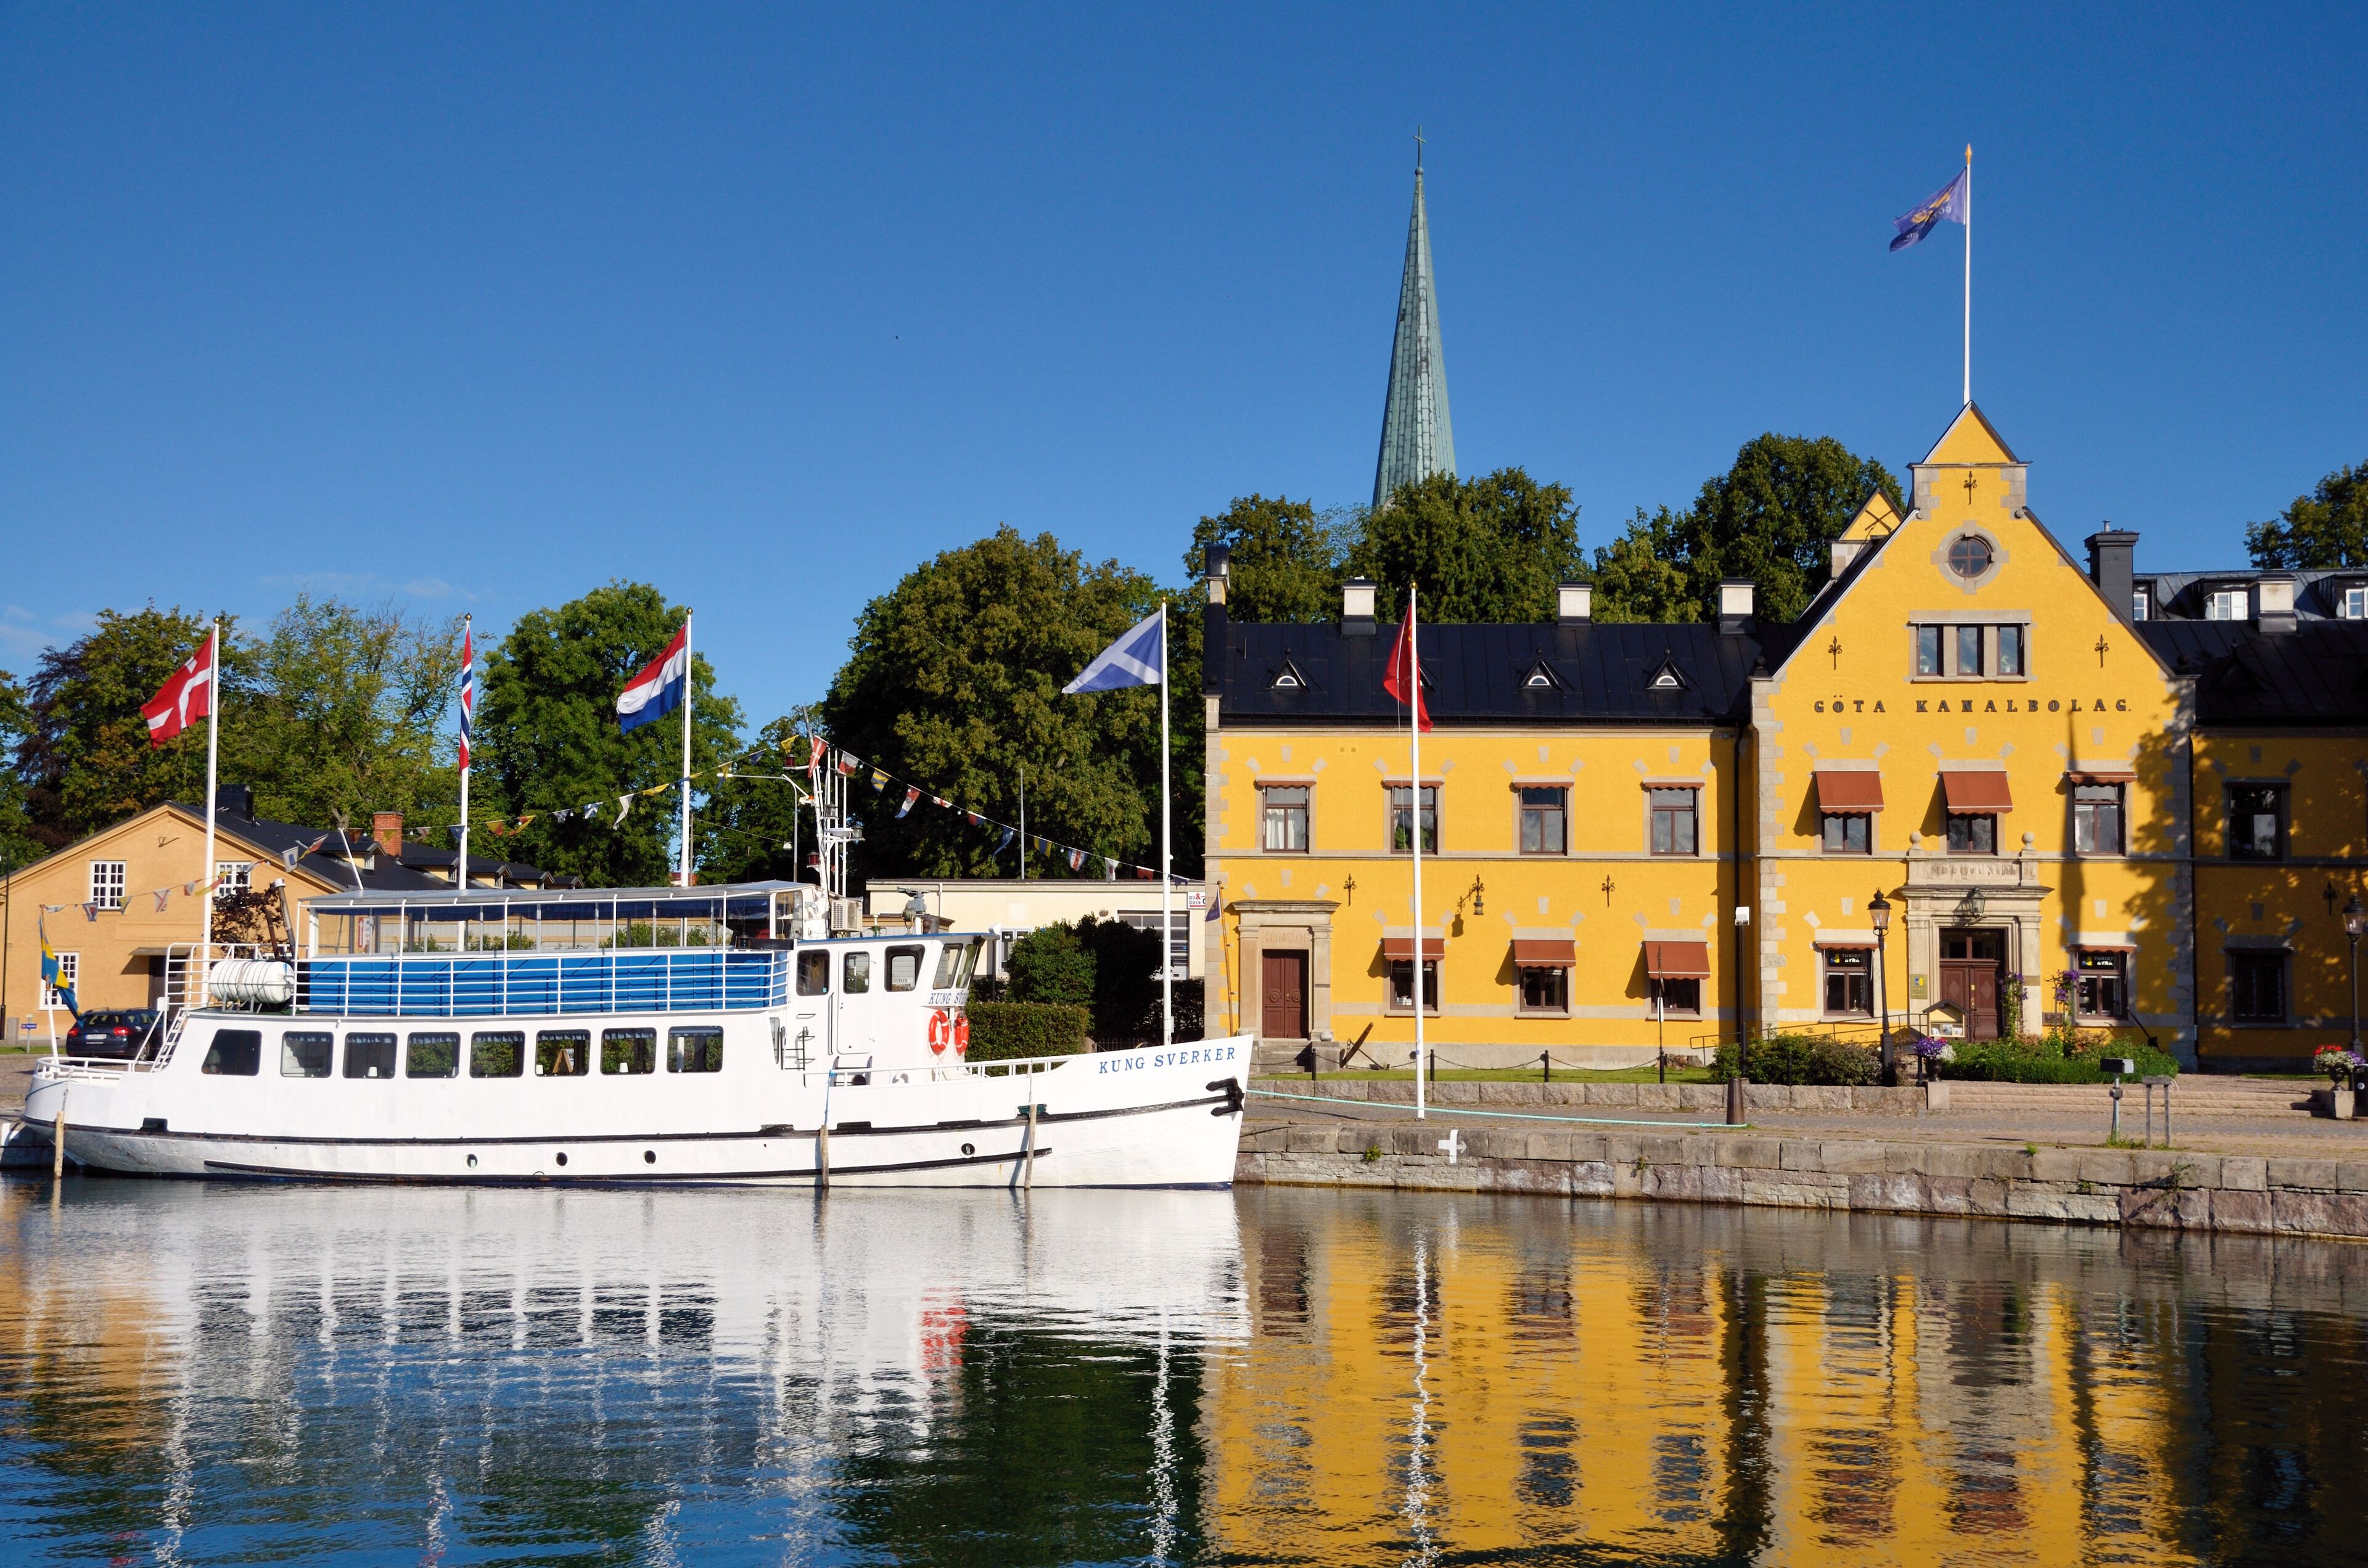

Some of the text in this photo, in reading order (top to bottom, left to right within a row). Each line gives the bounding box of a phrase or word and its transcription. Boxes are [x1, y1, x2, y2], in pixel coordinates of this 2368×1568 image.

[1814, 695, 1886, 713] GÖTA
[928, 993, 951, 1004] KUNG
[1100, 1047, 1235, 1074] KUNG SVERKER
